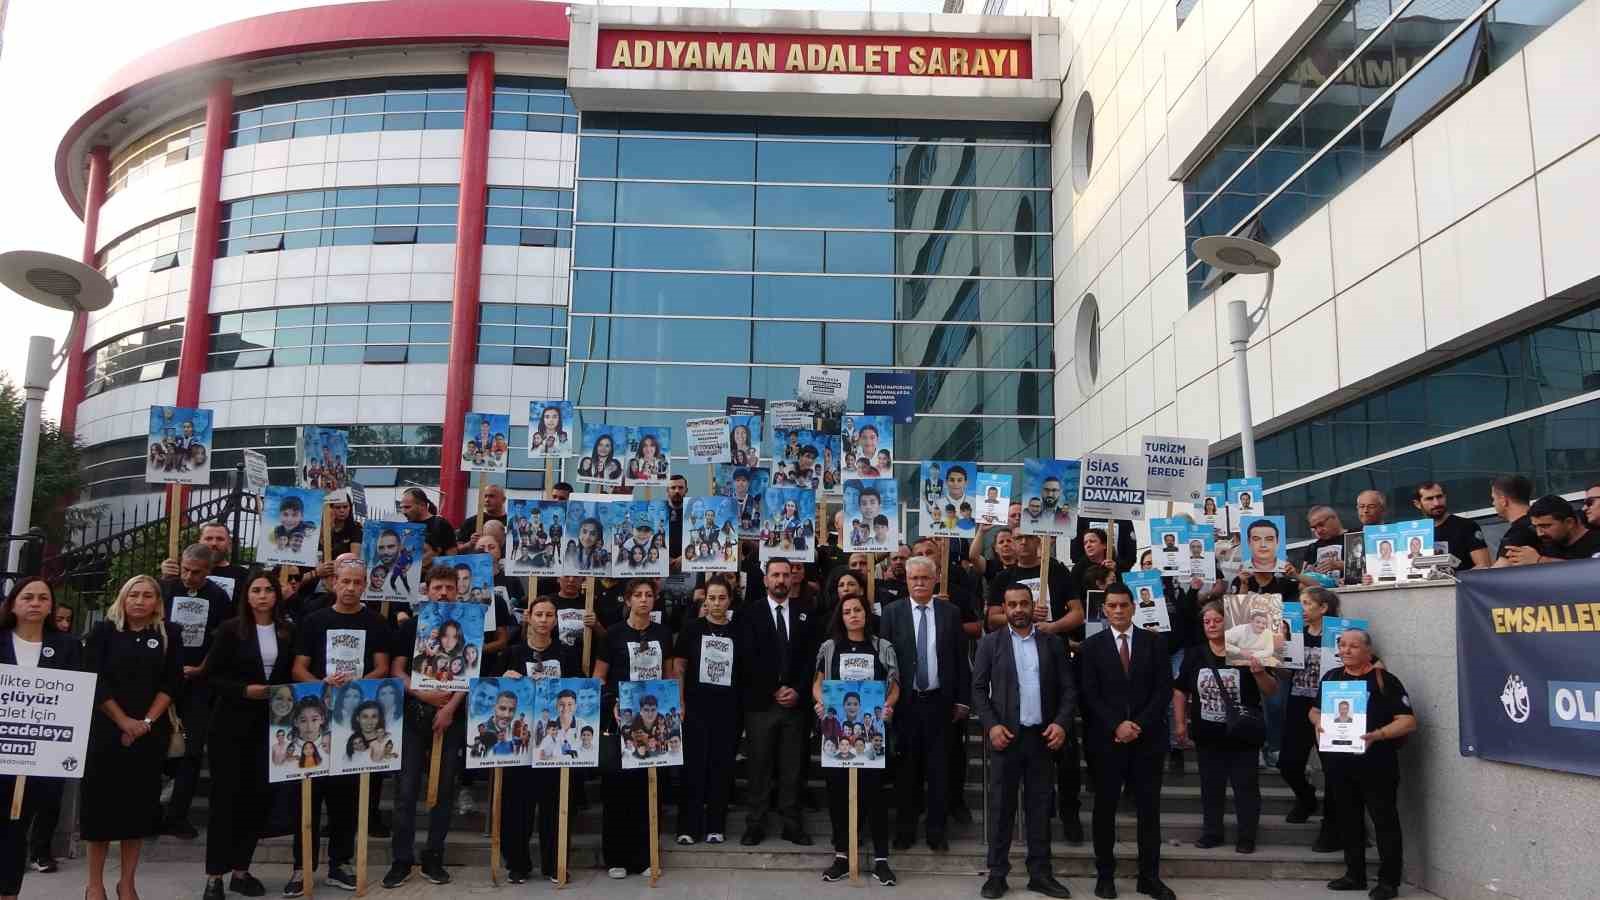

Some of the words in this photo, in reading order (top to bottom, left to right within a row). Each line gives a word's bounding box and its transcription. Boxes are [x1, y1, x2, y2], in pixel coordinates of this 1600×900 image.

[612, 39, 776, 71] ADIYAMAN
[784, 43, 901, 74] ADALET
[908, 46, 1019, 78] SARAYI
[1145, 441, 1186, 454] TURİZM
[1087, 458, 1120, 473] İSİAS
[1086, 475, 1129, 488] ORTAK
[1084, 489, 1143, 503] DAVAMIZ
[35, 678, 74, 691] Daha
